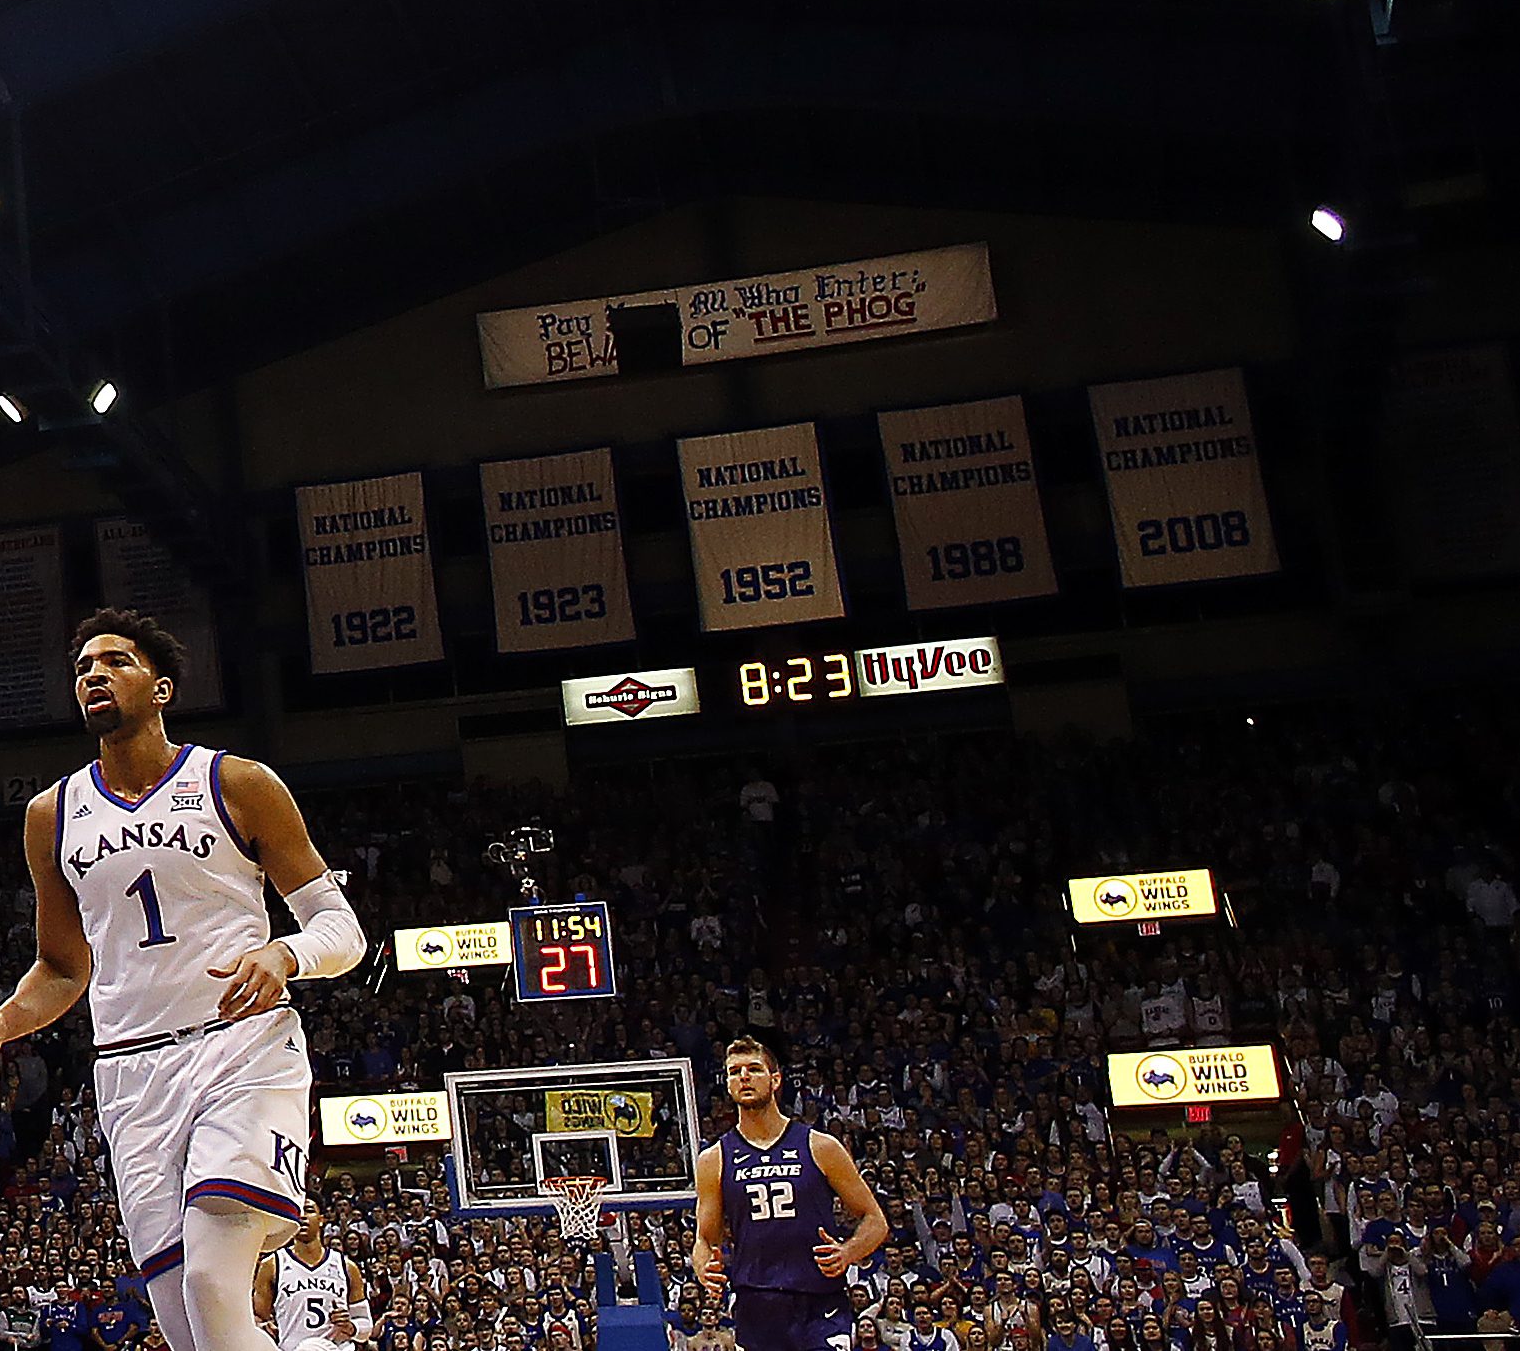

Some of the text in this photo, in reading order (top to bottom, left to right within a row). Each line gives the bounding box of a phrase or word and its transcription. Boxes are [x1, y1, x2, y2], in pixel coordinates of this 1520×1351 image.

[733, 280, 801, 310] Who
[687, 320, 730, 351] OF
[1113, 405, 1234, 439] NATIONAL
[899, 430, 1015, 465] NATIONAL
[1105, 435, 1251, 473] CHAMPIONS
[696, 455, 807, 489] NATIONAL
[892, 460, 1033, 497] CHAMPIONS
[498, 480, 602, 513] NATIONAL
[688, 485, 823, 522] CHAMPIONS
[313, 504, 413, 537] NATIONAL
[489, 510, 617, 545] CHAMPIONS
[1136, 509, 1251, 558] 2008
[306, 532, 427, 567] CHAMPIONS
[926, 535, 1026, 583] 1988
[719, 560, 815, 605] 1952
[516, 583, 608, 626] 1923
[331, 604, 417, 648] 1922
[739, 653, 853, 706] 8:23
[68, 822, 217, 880] KANSAS
[1139, 875, 1186, 886] BUFFALO
[1140, 886, 1189, 900] WILD
[125, 868, 177, 948] 1
[1143, 899, 1190, 912] WINGS
[455, 927, 496, 937] BUFFALO
[456, 936, 497, 950] WILD
[534, 914, 602, 942] 11:54
[458, 949, 499, 960] WINGS
[540, 944, 600, 994] 27
[1188, 1052, 1245, 1064] BUFFALO
[1190, 1063, 1248, 1080] WILD
[388, 1097, 437, 1108] BUFFALO
[1194, 1080, 1250, 1095] WINGS
[390, 1107, 438, 1123] WILD
[392, 1122, 439, 1136] WINGS
[735, 1164, 802, 1181] K-STATE
[745, 1181, 796, 1221] 32
[281, 1277, 346, 1298] KANSAS
[305, 1297, 326, 1329] 5
